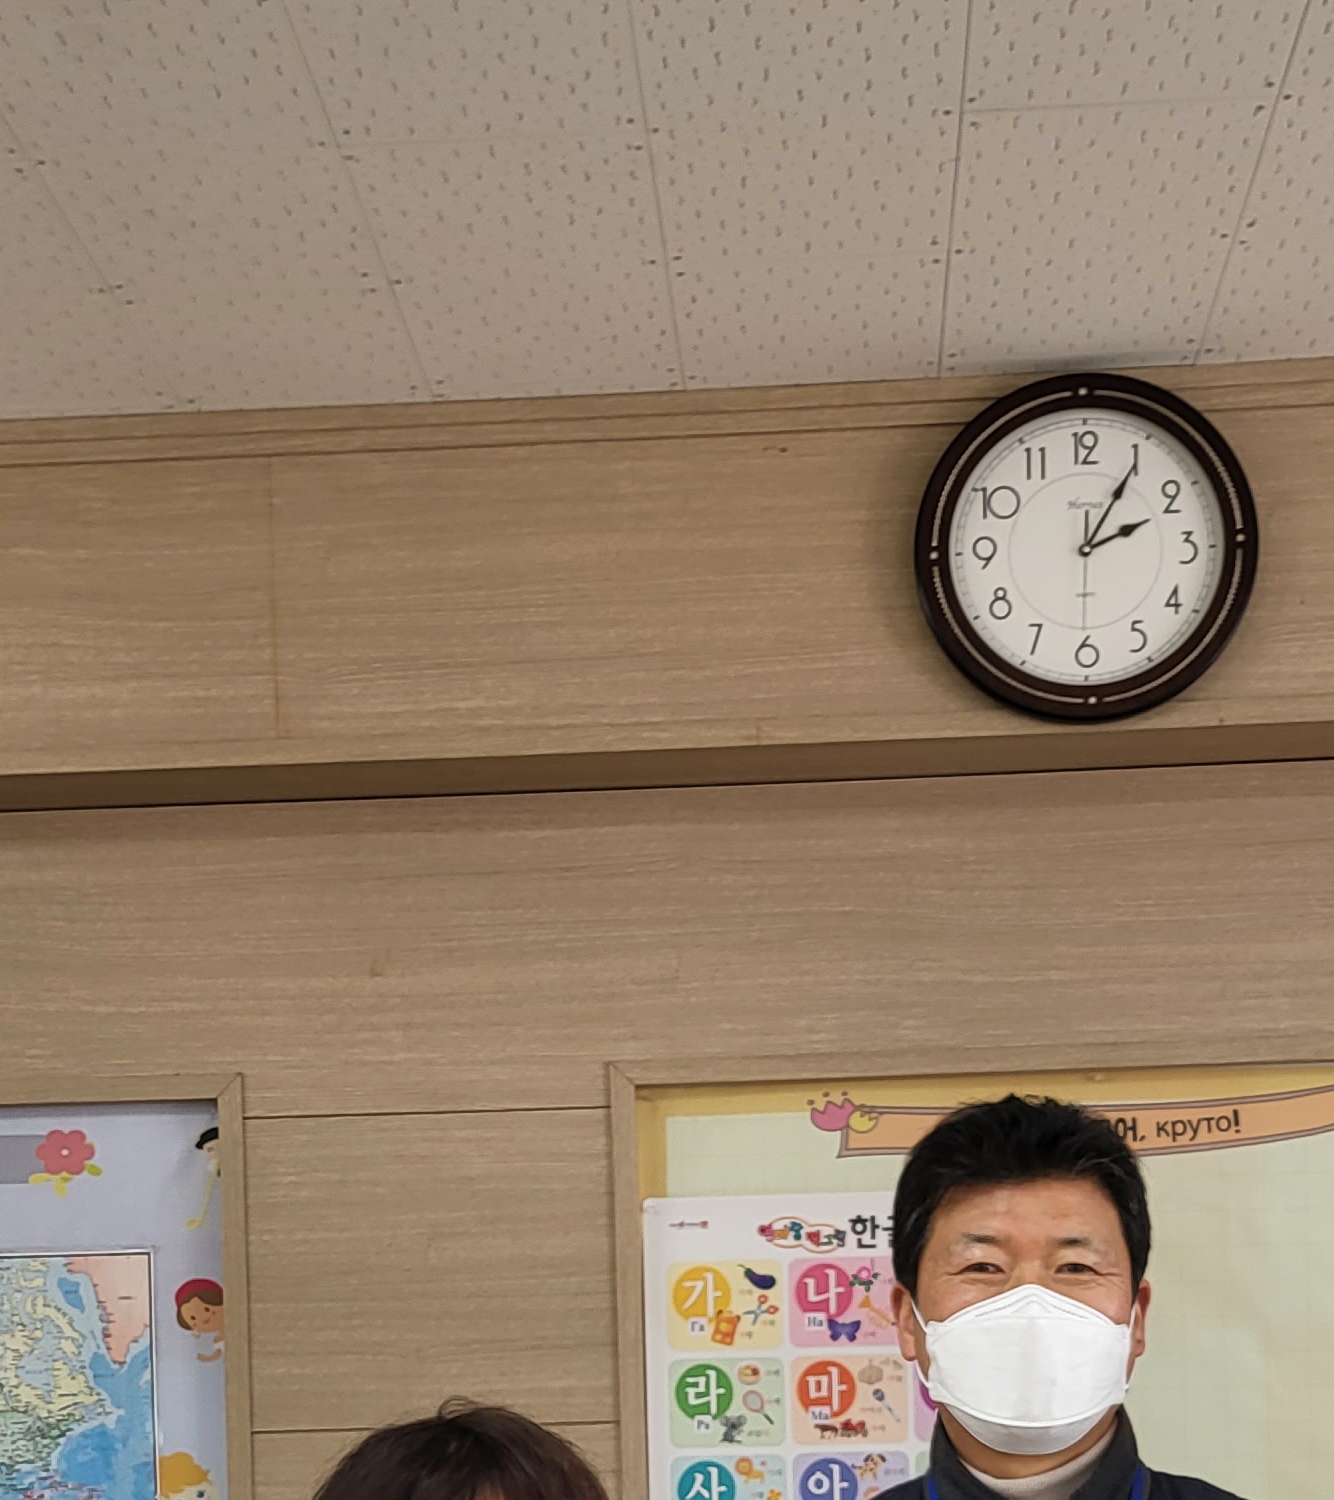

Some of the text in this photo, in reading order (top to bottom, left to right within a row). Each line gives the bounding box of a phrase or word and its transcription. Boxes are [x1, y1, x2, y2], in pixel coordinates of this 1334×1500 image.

[1025, 447, 1046, 480] 11
[1071, 430, 1100, 465] 12
[1131, 443, 1140, 476] 1
[979, 485, 1021, 520] 10
[1161, 479, 1182, 514] 2
[972, 536, 998, 570] 9
[1178, 531, 1199, 565] 3
[988, 586, 1012, 620] 8
[1164, 584, 1184, 615] 4
[1028, 623, 1044, 656] 7
[1074, 634, 1100, 668] 6
[1129, 620, 1148, 653] 5
[1114, 1109, 1241, 1142] 어, круто!
[682, 1271, 723, 1318] 가
[803, 1268, 846, 1315] 나
[684, 1368, 726, 1415] 라
[805, 1366, 848, 1412] 마
